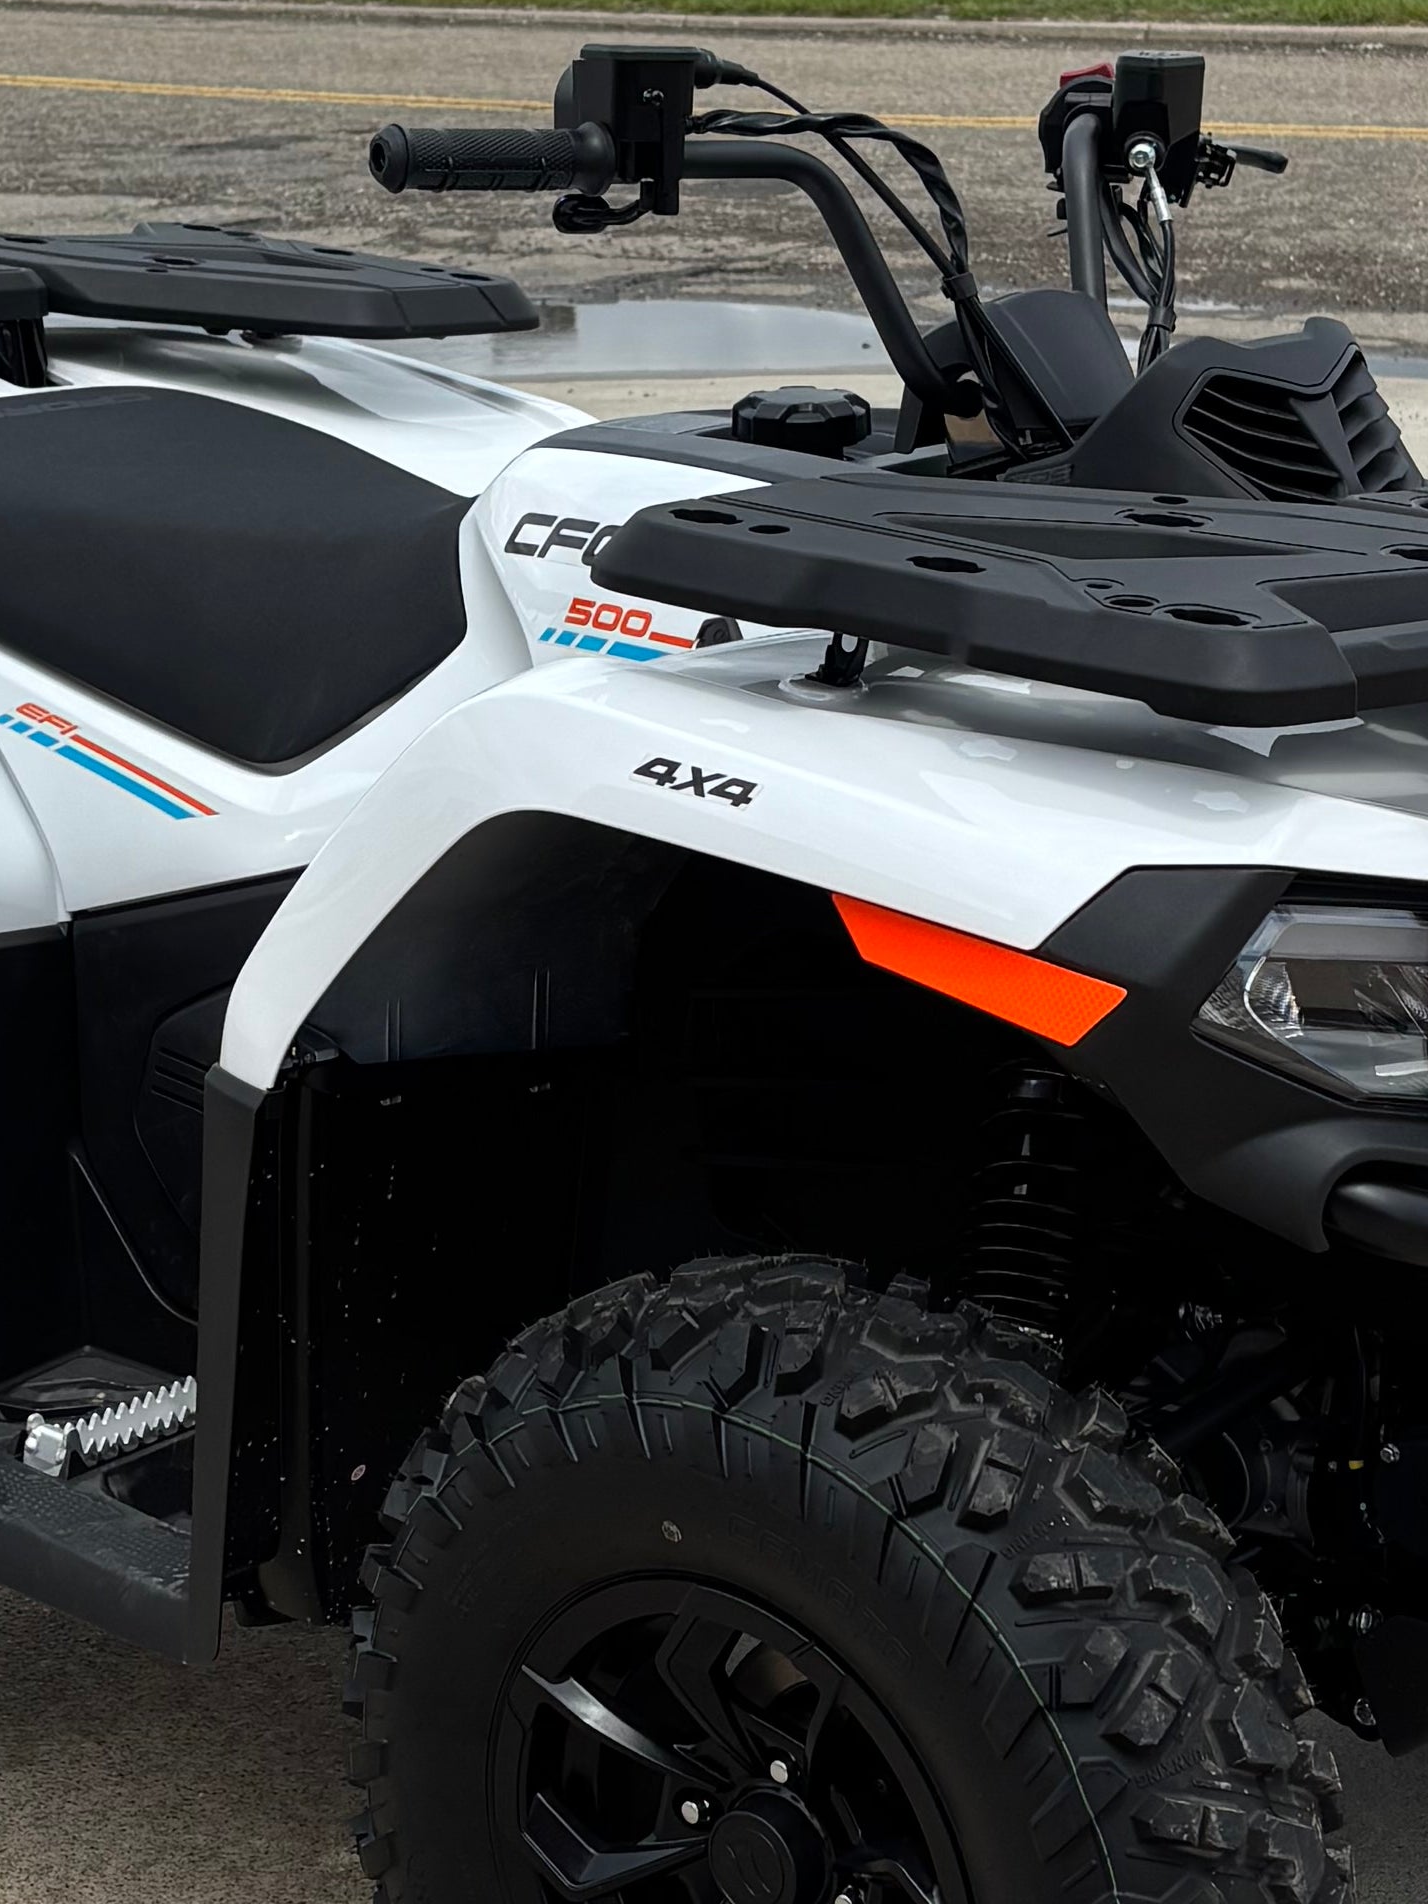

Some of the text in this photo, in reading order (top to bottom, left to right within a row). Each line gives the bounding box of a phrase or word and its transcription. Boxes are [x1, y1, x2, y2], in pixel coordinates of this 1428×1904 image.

[504, 512, 623, 567] CFO
[564, 597, 653, 638] 500
[15, 702, 79, 735] EFI
[633, 757, 758, 808] 4X4
